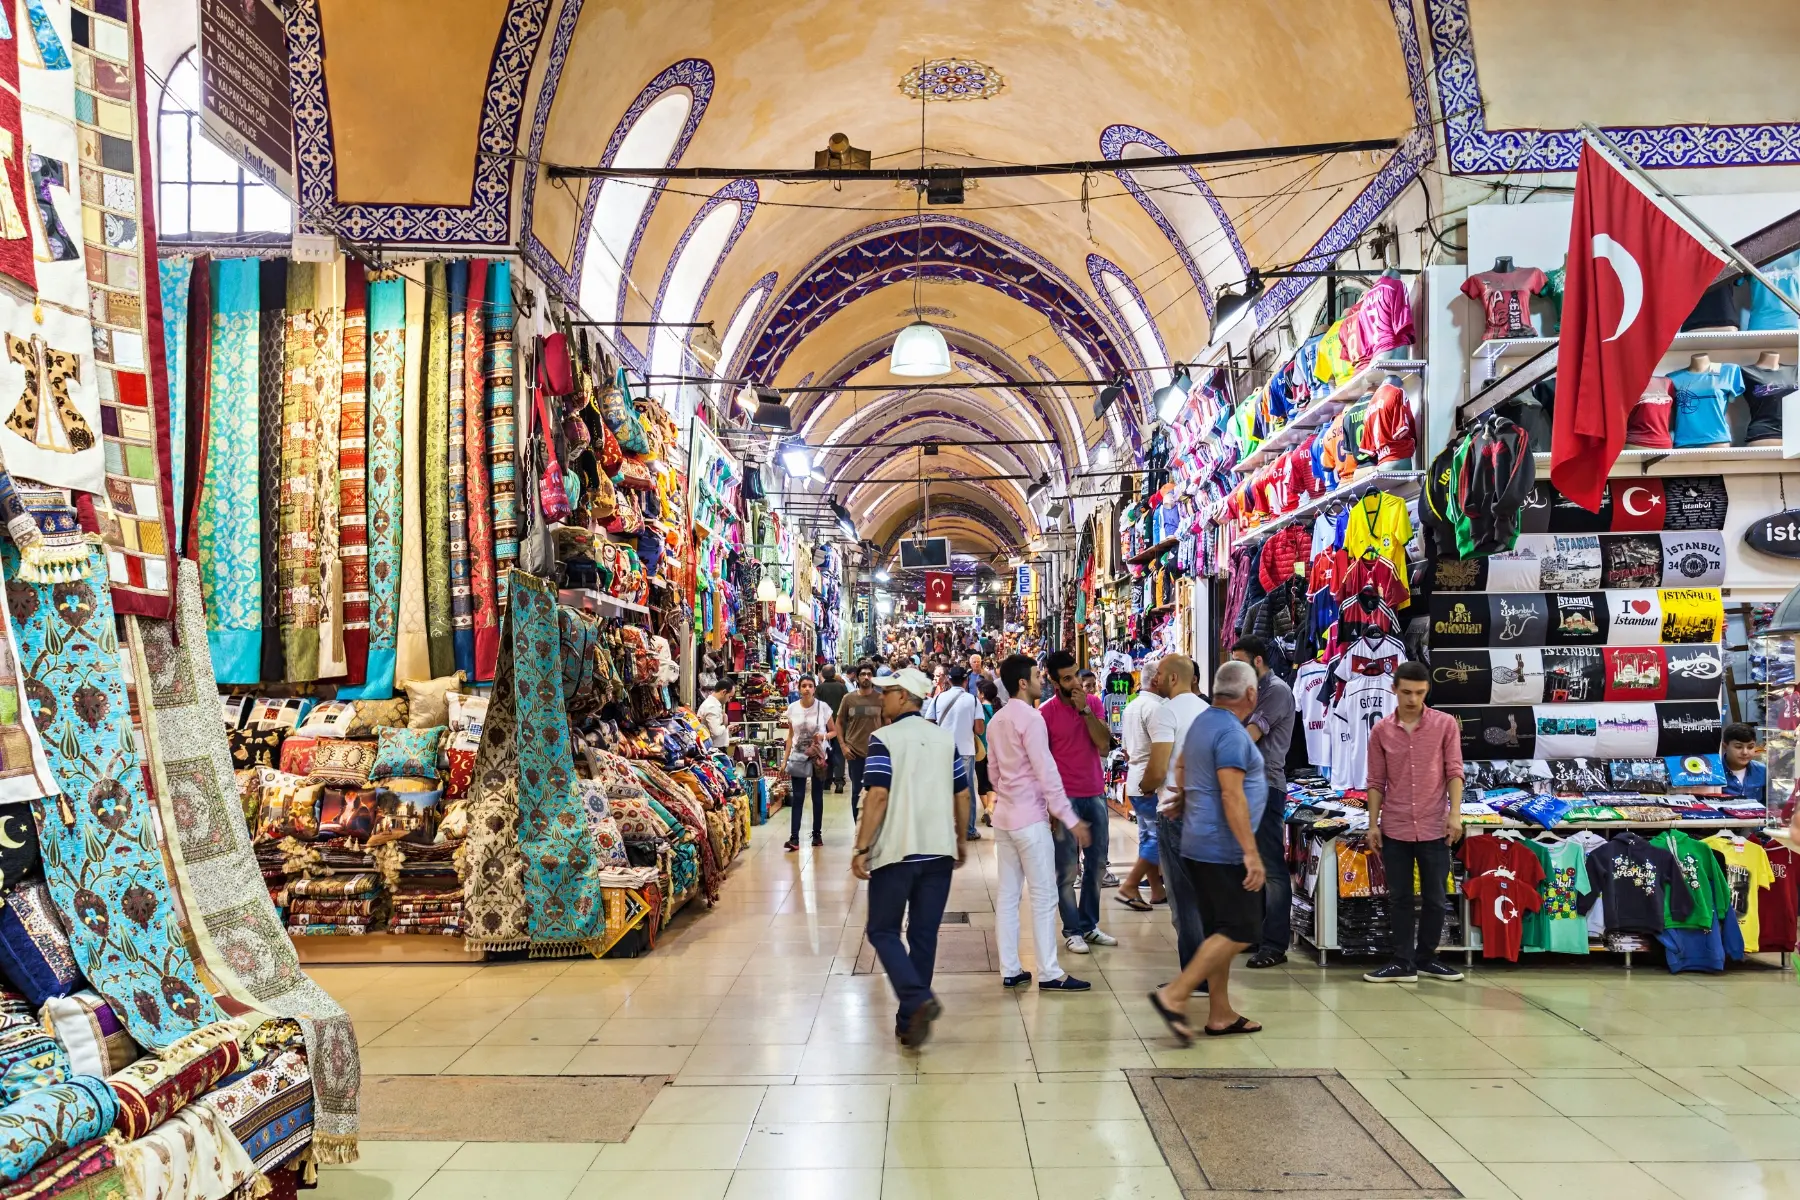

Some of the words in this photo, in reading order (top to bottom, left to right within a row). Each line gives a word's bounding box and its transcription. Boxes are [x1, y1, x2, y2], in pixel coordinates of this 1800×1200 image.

[216, 5, 245, 40] SAHAFLAR
[245, 32, 273, 67] BEDESTENİ
[217, 29, 245, 62] HALICILAR
[218, 77, 255, 117] KALPAKÇILAR
[255, 109, 267, 128] CAD.
[242, 77, 270, 109] BEDESTENİ
[237, 119, 257, 142] POLICE
[1666, 541, 1721, 557] İSTANBUL
[1668, 561, 1679, 570] 34
[1709, 561, 1721, 570] TR
[1019, 566, 1030, 593] EGE
[1557, 593, 1594, 607] İSTANBUL
[1622, 600, 1630, 614] I
[1449, 610, 1472, 623] Last
[1614, 613, 1658, 626] İstanbul
